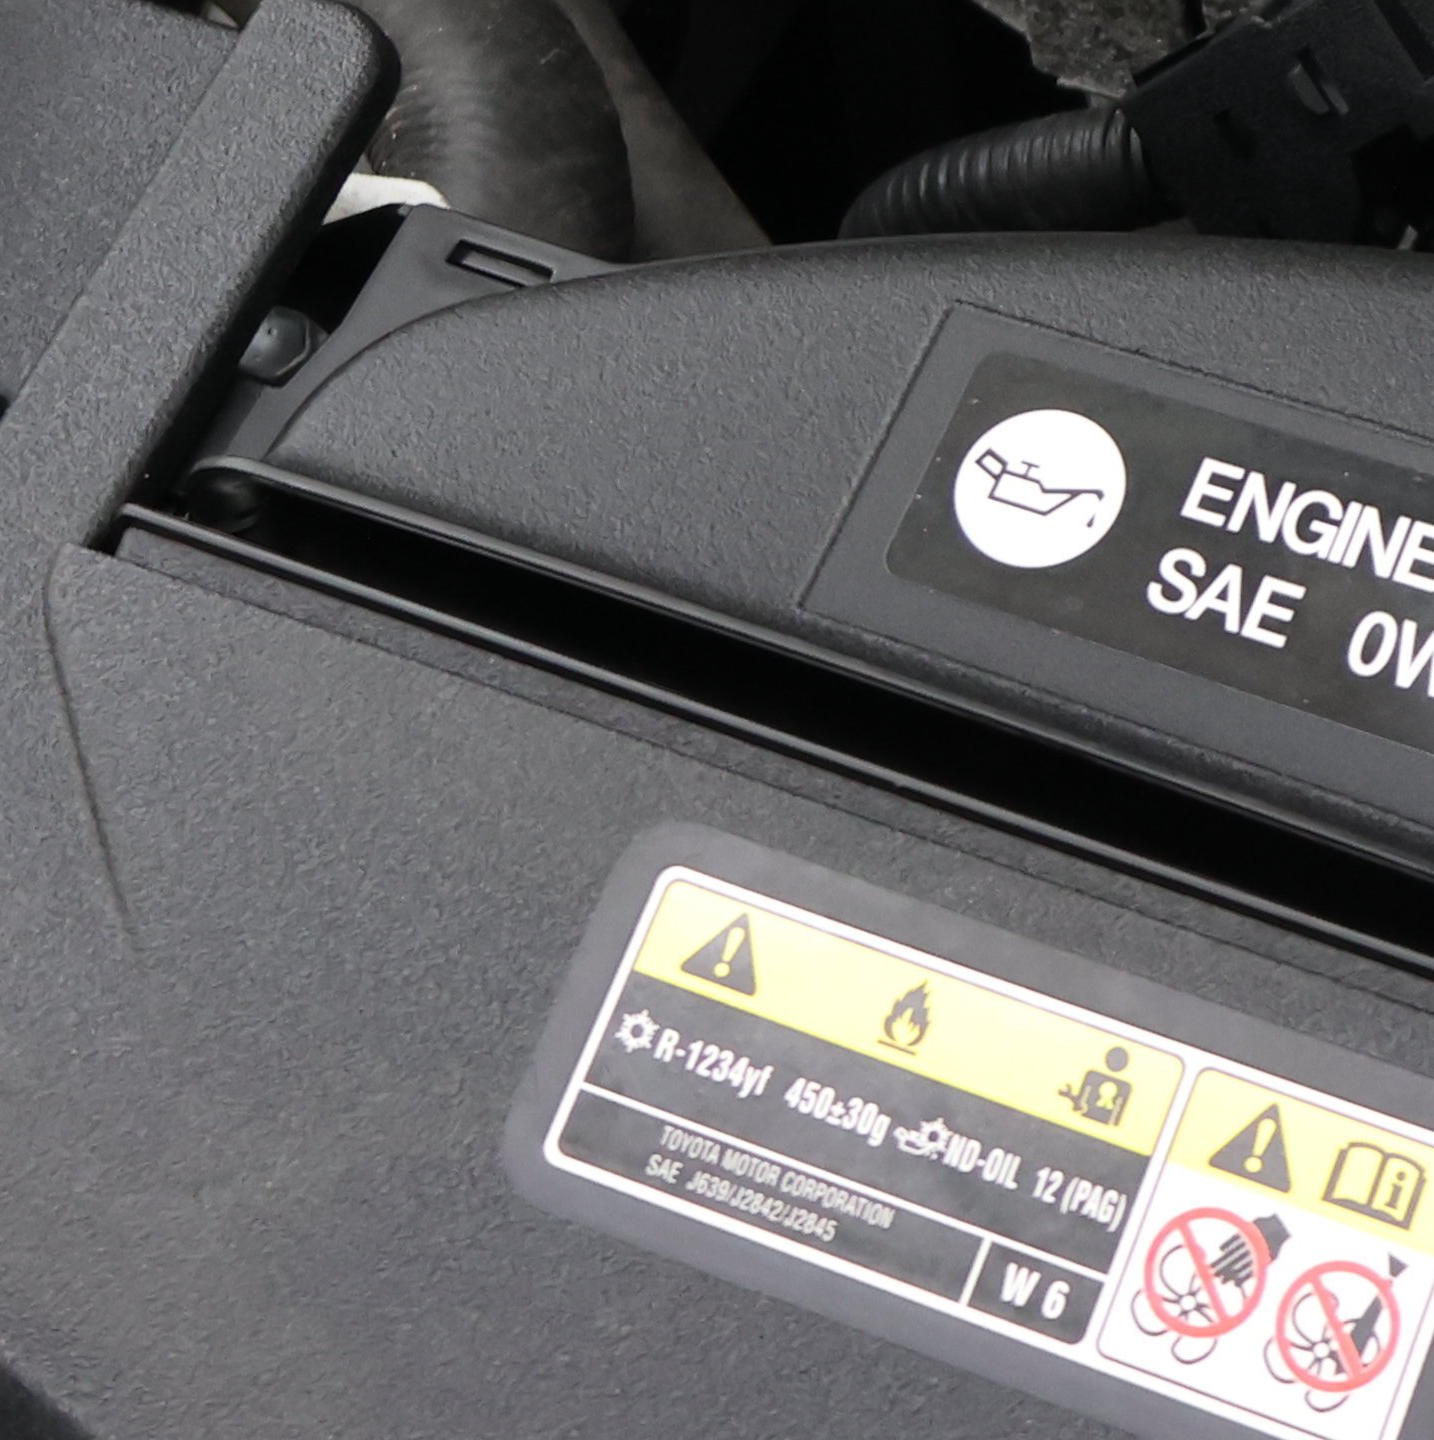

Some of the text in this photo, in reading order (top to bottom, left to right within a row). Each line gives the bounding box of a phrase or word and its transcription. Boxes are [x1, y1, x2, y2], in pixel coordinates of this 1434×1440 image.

[1146, 547, 1307, 649] SAE
[644, 1153, 684, 1184] SAE
[653, 1027, 1128, 1233] R-1234yf 450±30g ND-OIL 12 (PAG)
[659, 1124, 896, 1229] TOYOTA MOTOR CORPORATION
[1000, 1262, 1071, 1320] W 6
